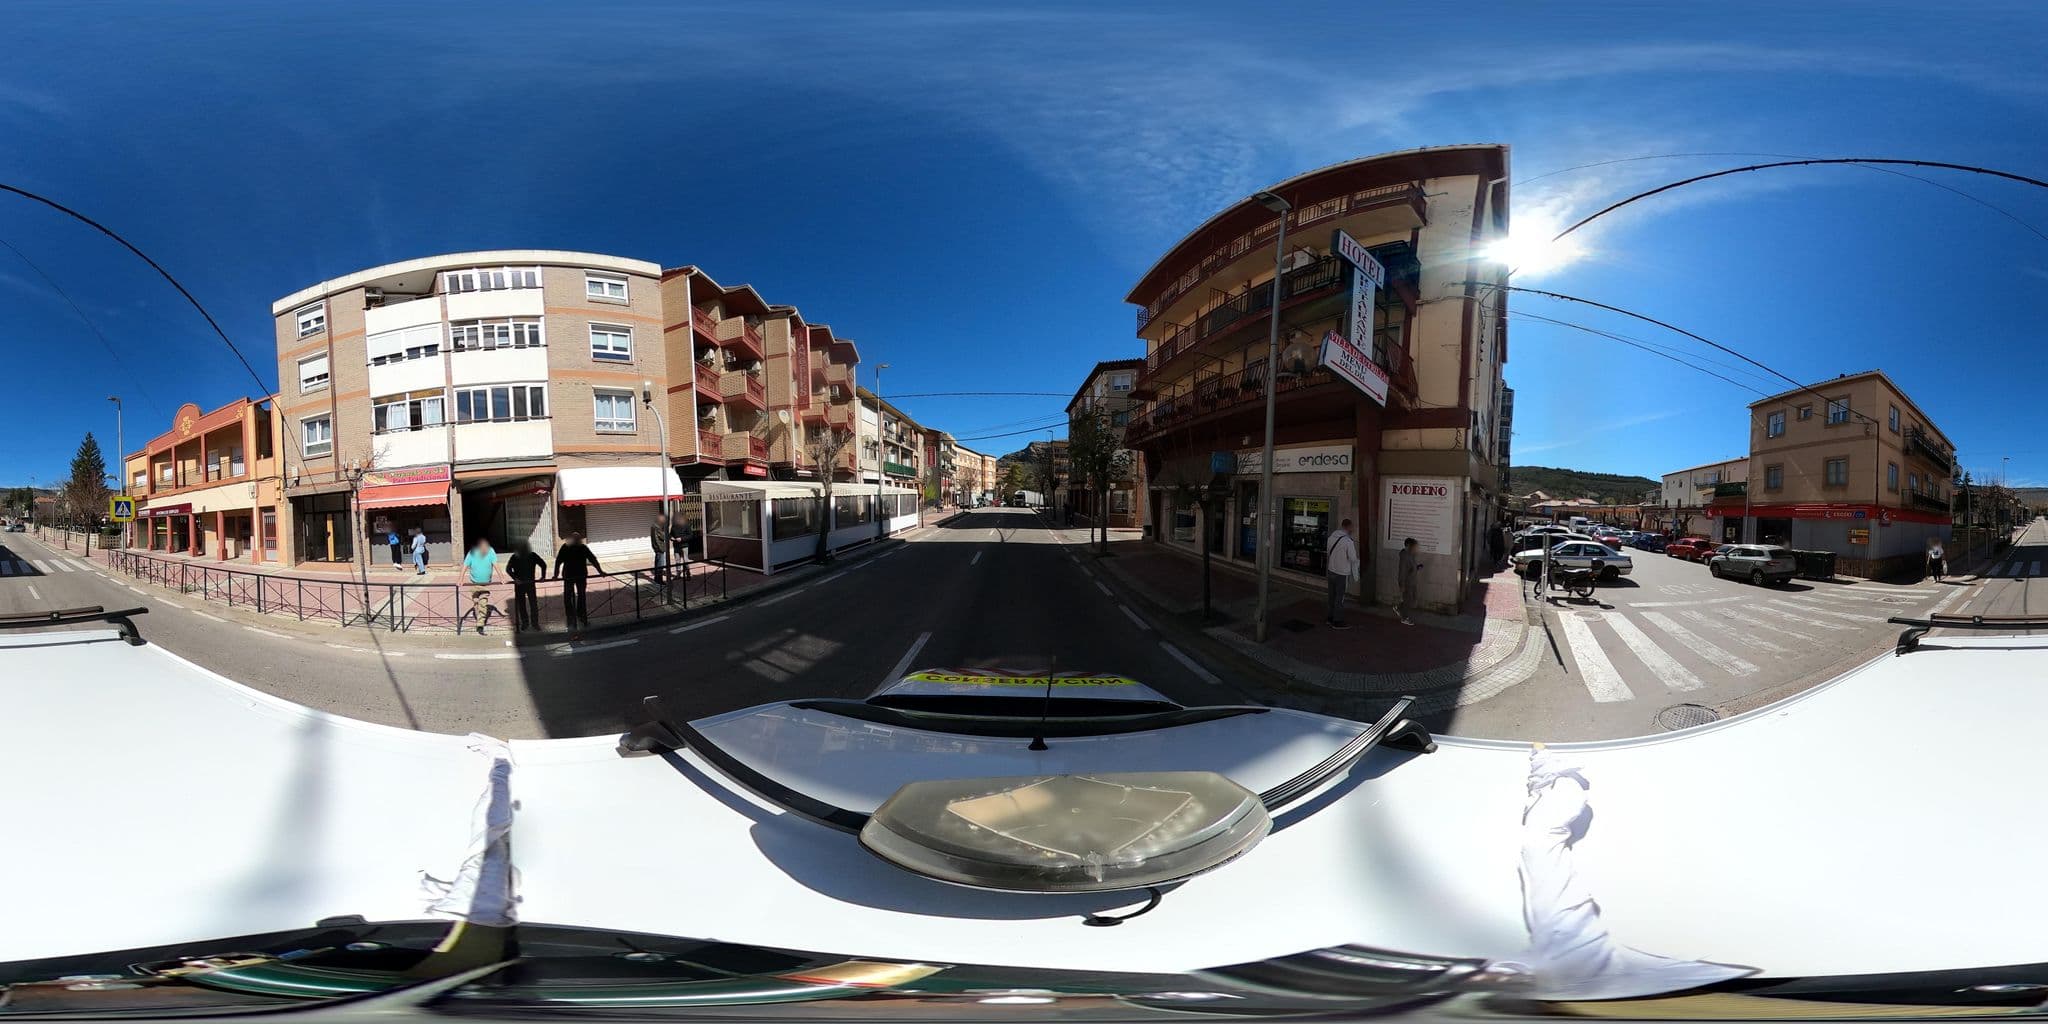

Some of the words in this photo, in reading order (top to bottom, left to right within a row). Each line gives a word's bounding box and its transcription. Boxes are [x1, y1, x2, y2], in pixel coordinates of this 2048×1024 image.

[1342, 236, 1382, 284] HOTEL
[1298, 453, 1349, 466] endesa
[1391, 485, 1447, 496] MORENO
